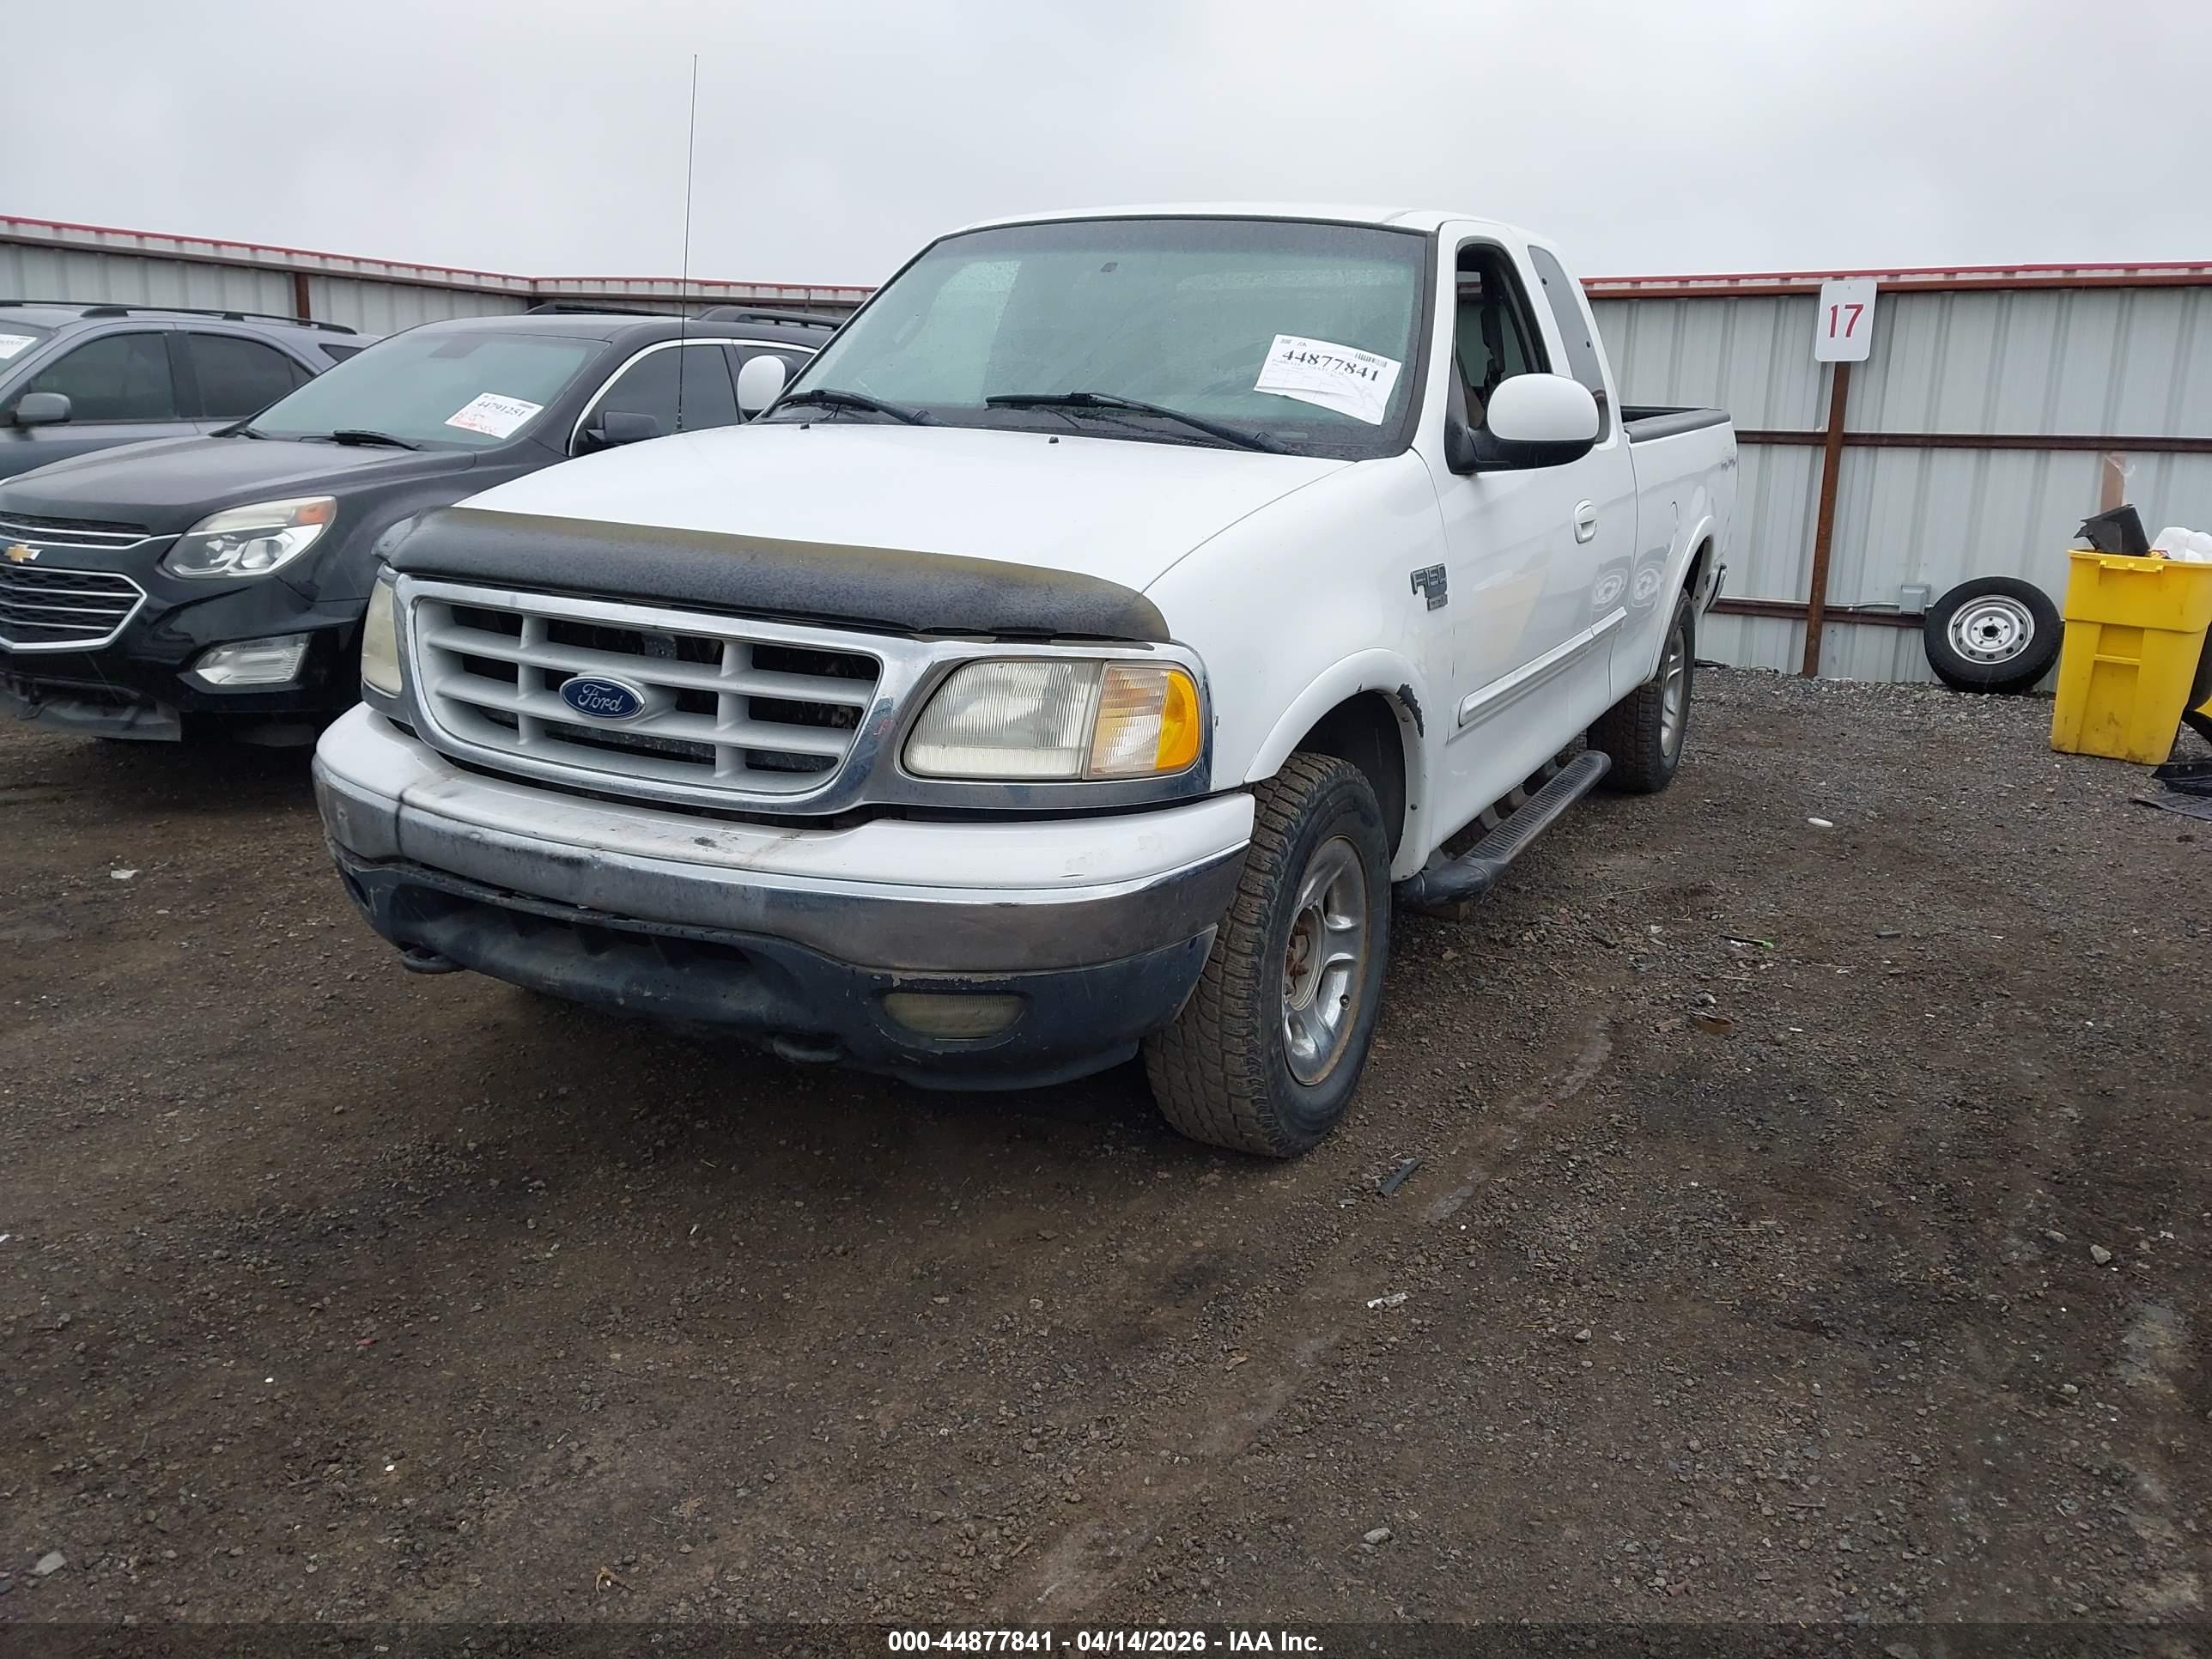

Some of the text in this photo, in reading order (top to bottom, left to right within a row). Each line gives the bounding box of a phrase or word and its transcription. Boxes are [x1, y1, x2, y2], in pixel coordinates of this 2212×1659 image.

[1830, 304, 1864, 337] 17
[1282, 349, 1380, 381] 44877841
[577, 684, 623, 712] Ford
